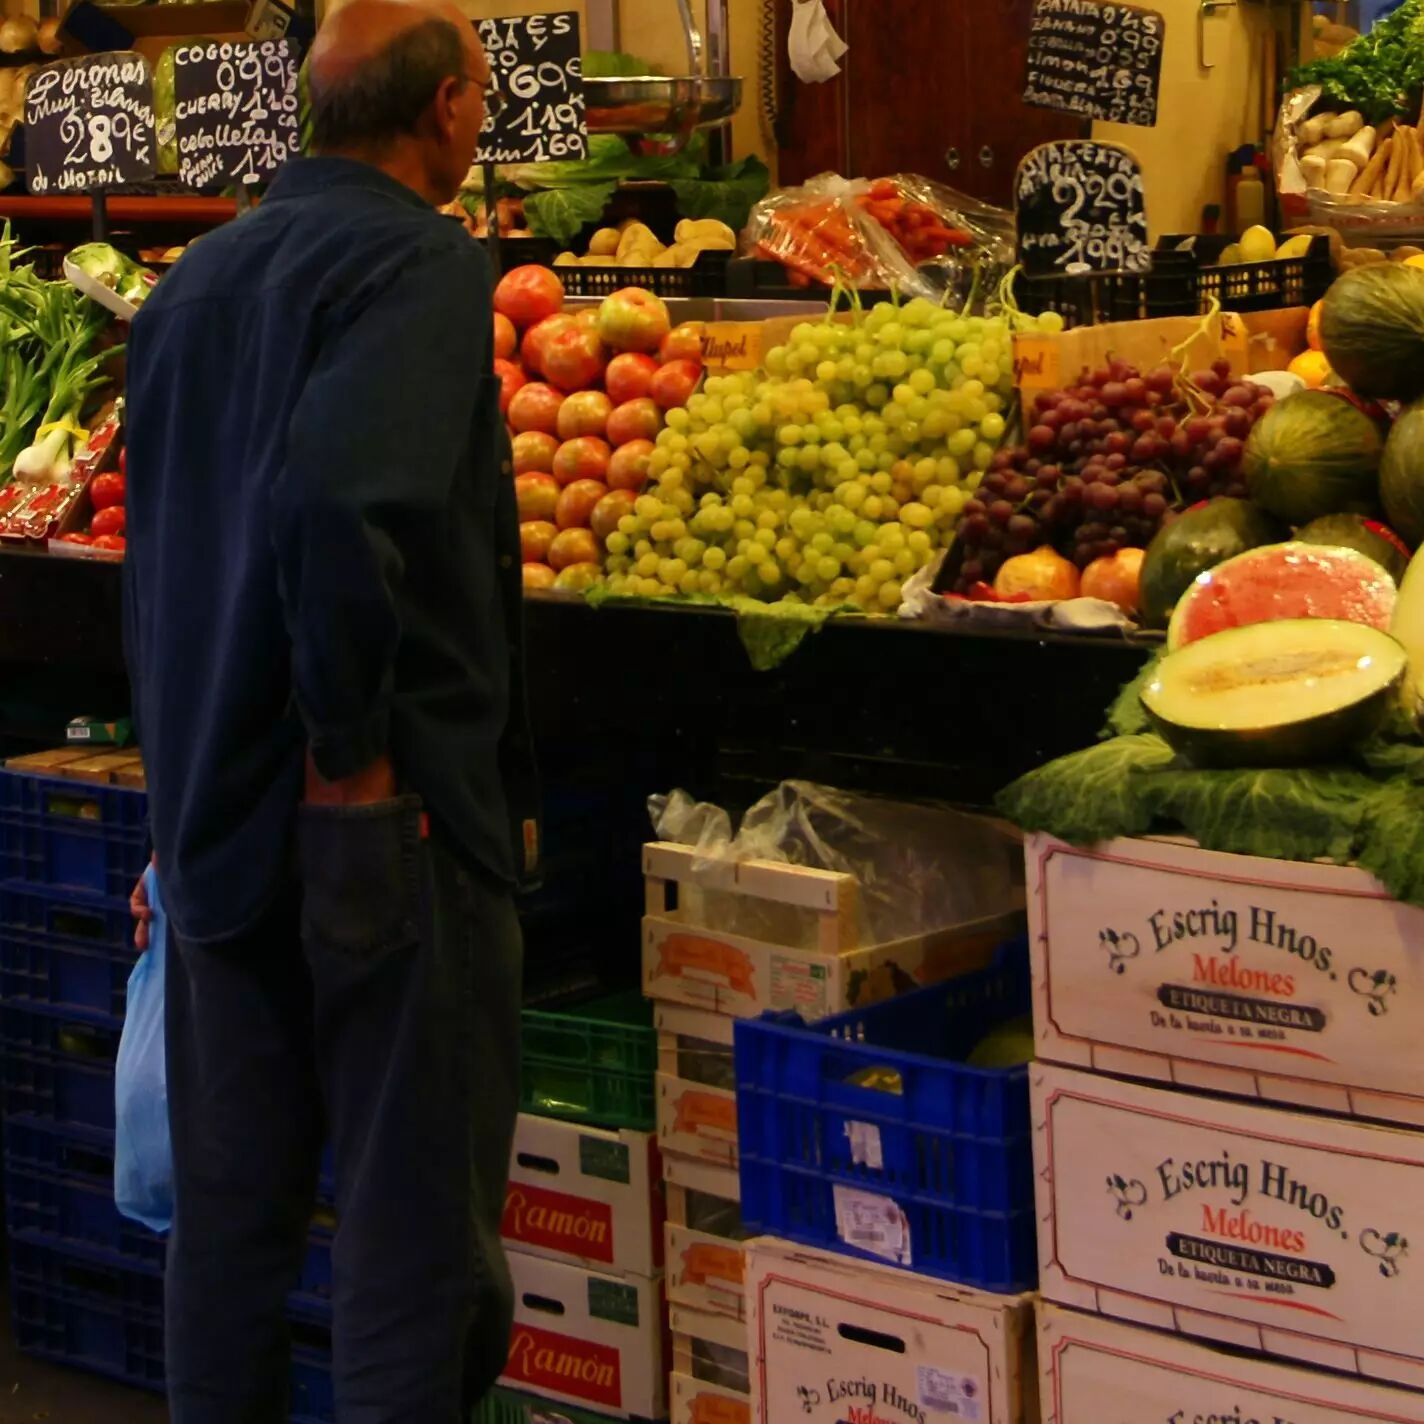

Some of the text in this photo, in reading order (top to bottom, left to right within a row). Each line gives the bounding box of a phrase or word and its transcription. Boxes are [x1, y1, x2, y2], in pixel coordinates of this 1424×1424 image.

[176, 39, 289, 65] COGOLLOS
[1147, 899, 1337, 981] Escrig Hnos.
[1192, 953, 1295, 997] Melones
[1255, 1006, 1314, 1027] NEGRA
[1156, 1150, 1349, 1240] Escrig Hnos.
[1201, 1203, 1306, 1253] Melones
[1179, 1239, 1323, 1283] ETIQUETA NEGRA
[826, 1377, 876, 1404] Escrig
